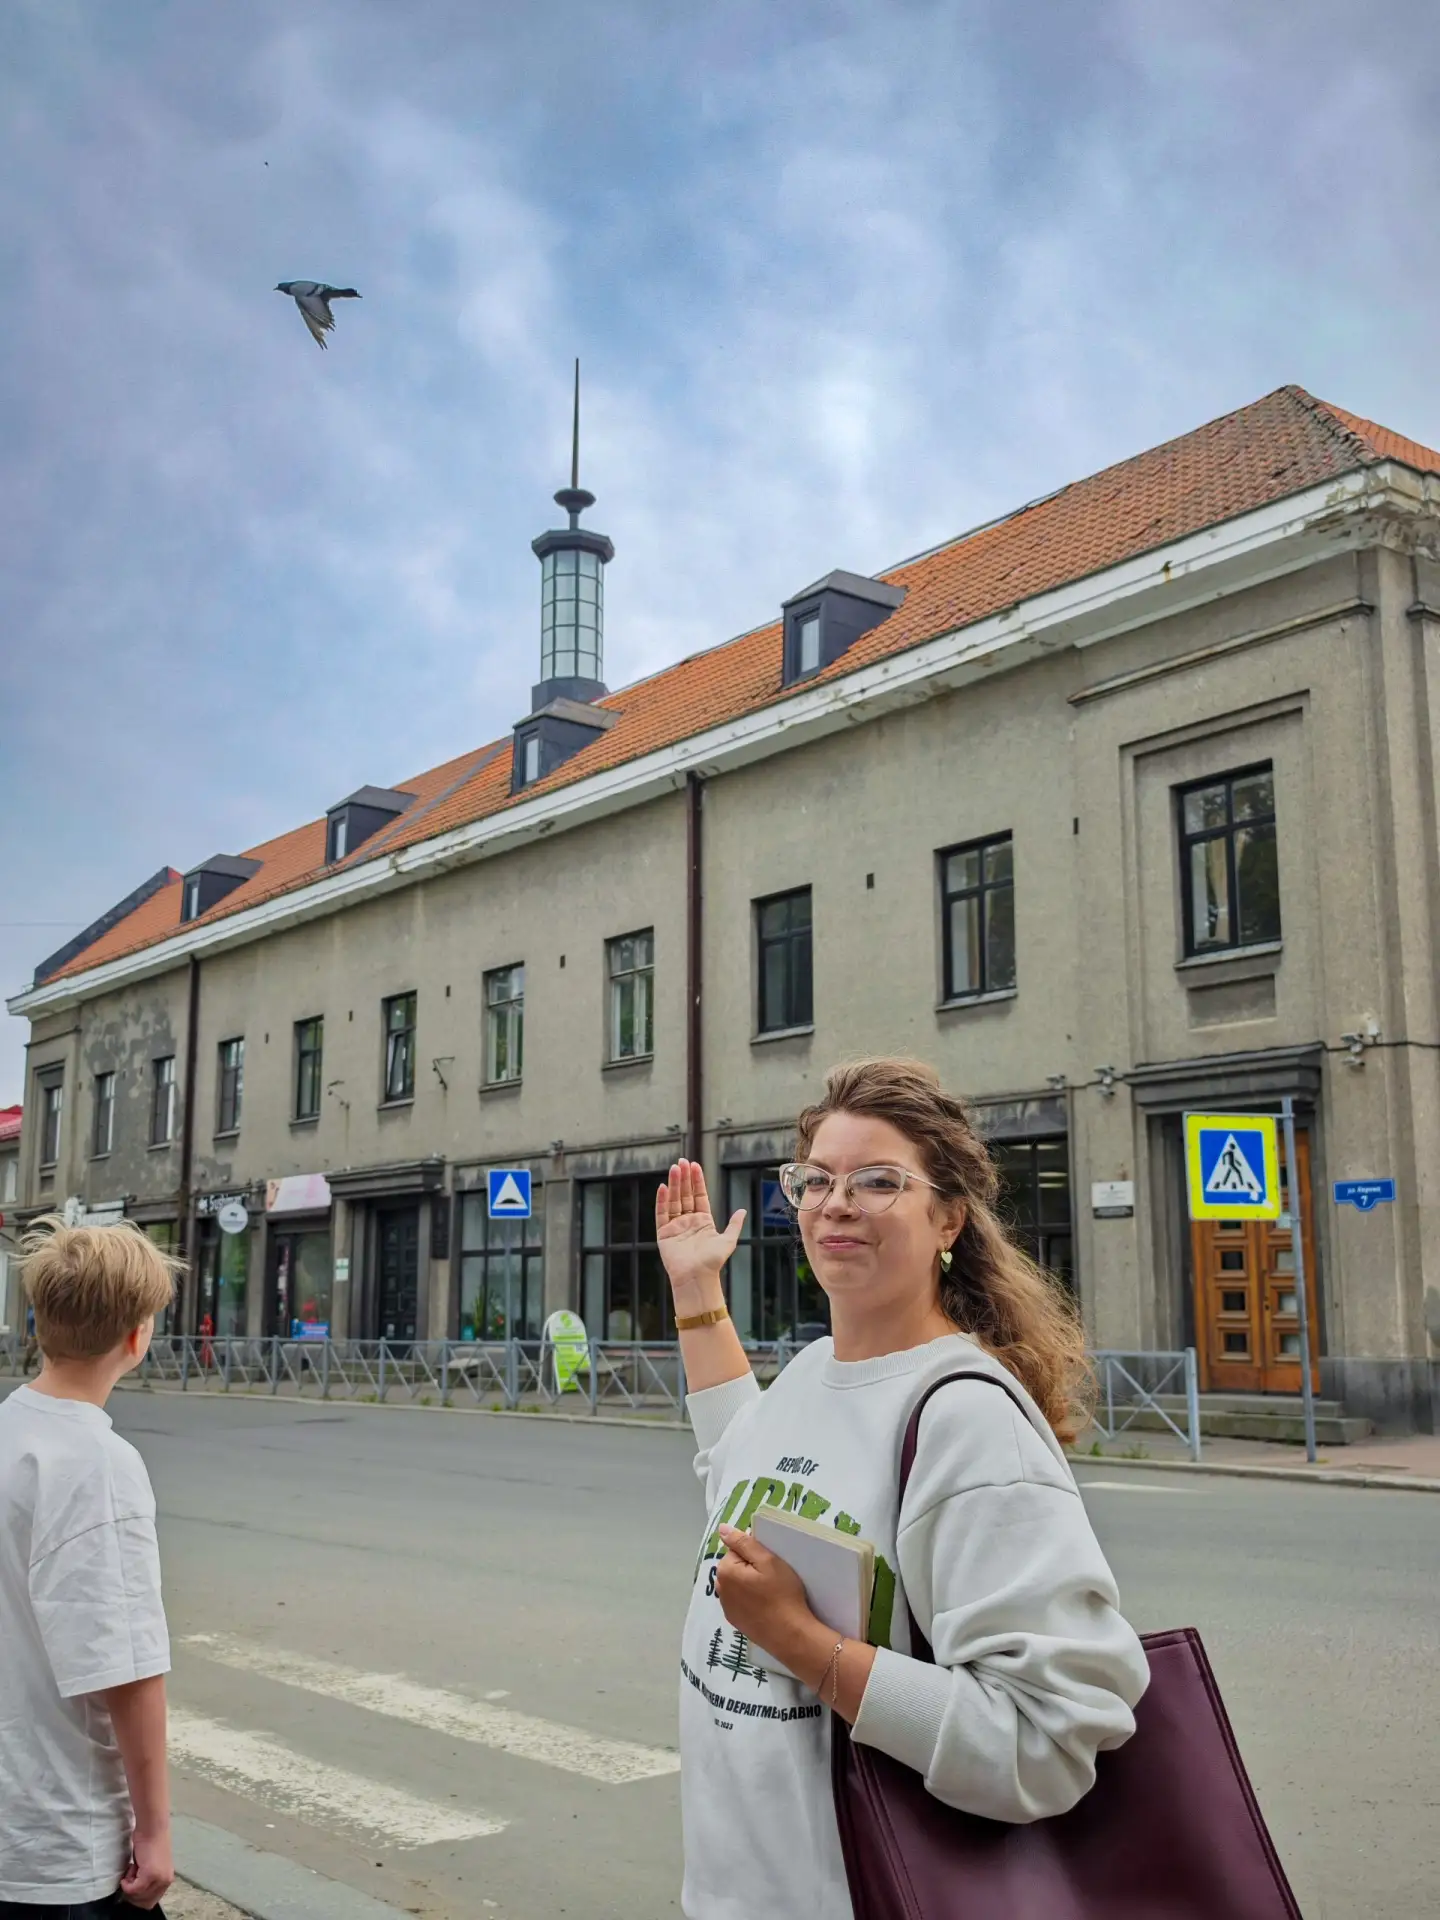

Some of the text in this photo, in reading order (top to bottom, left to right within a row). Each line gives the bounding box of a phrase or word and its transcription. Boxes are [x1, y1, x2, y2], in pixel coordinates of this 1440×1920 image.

[1361, 1195, 1368, 1206] 7
[801, 1459, 819, 1476] OF
[702, 1681, 725, 1708] NHERN
